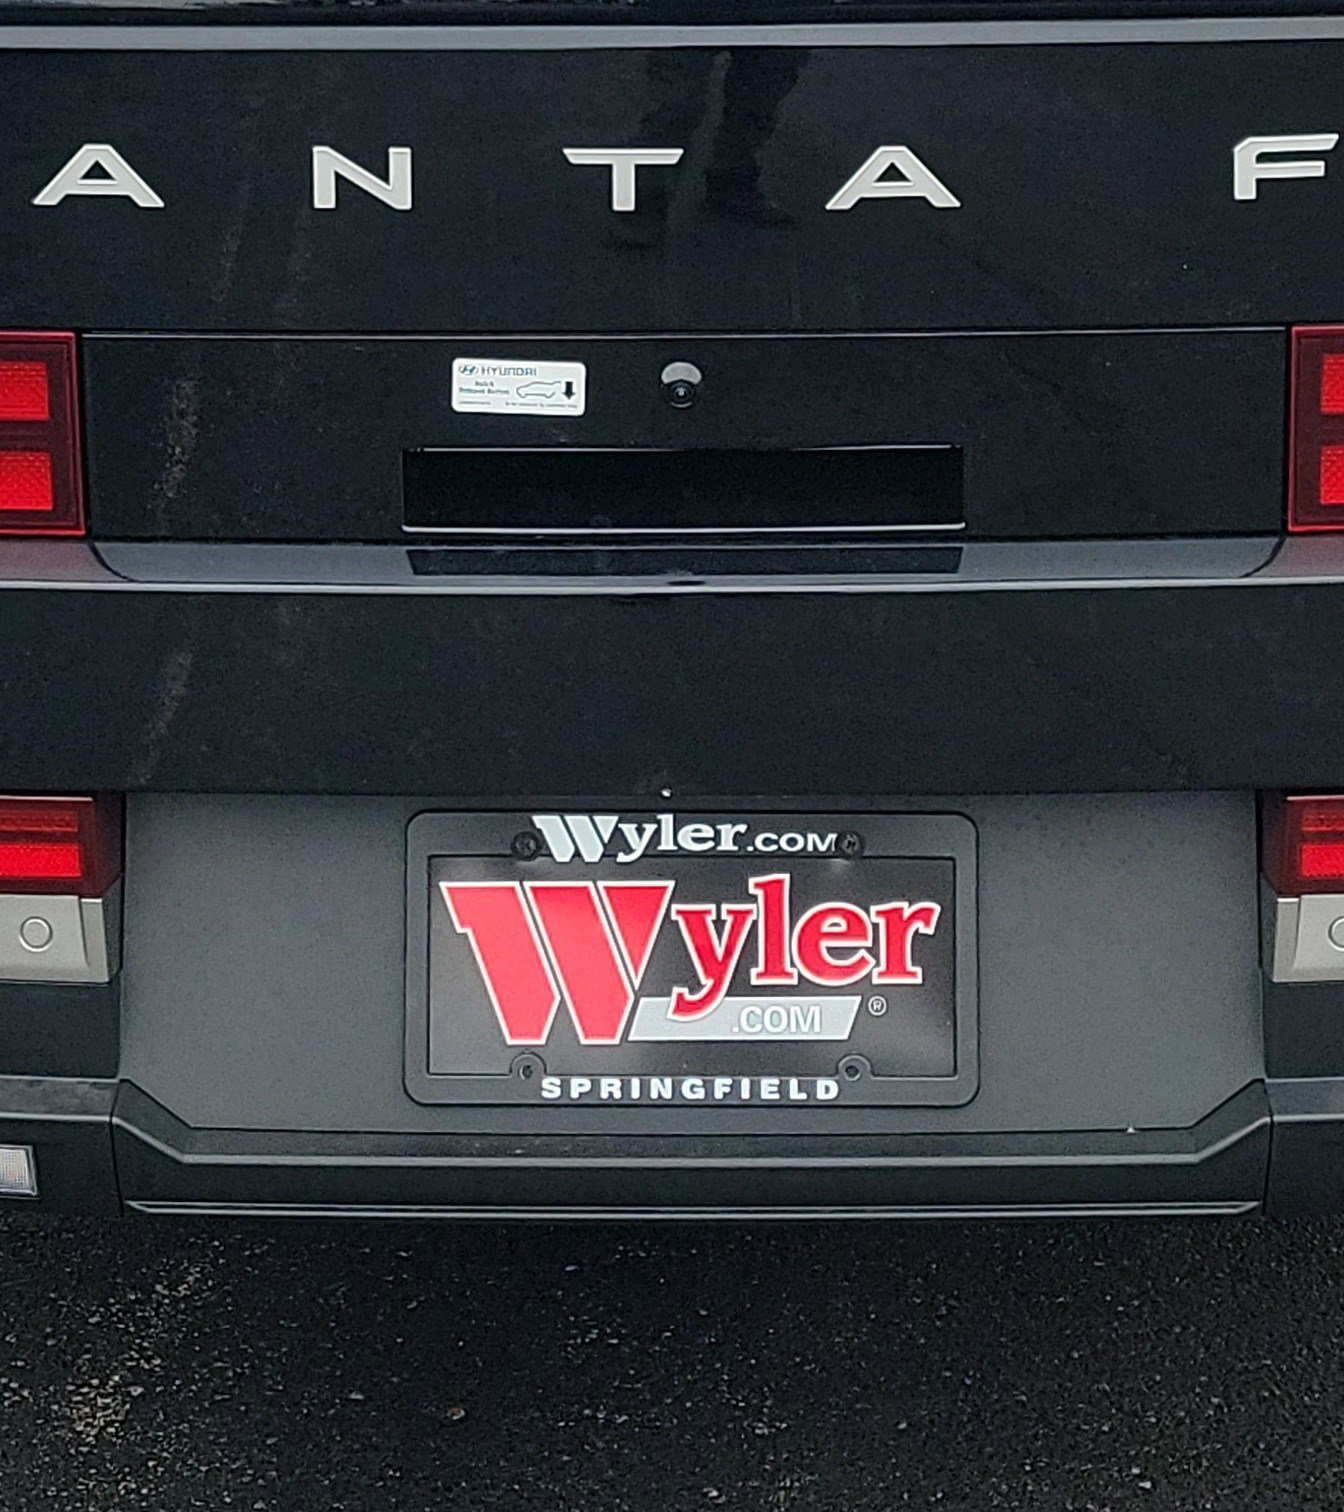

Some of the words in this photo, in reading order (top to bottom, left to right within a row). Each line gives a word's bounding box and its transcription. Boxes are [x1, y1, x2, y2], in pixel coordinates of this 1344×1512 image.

[481, 366, 537, 377] HYUNDAI
[438, 873, 942, 1046] Wyler
[731, 1005, 822, 1034] .COM
[540, 1076, 840, 1100] SPRINGFIELD
